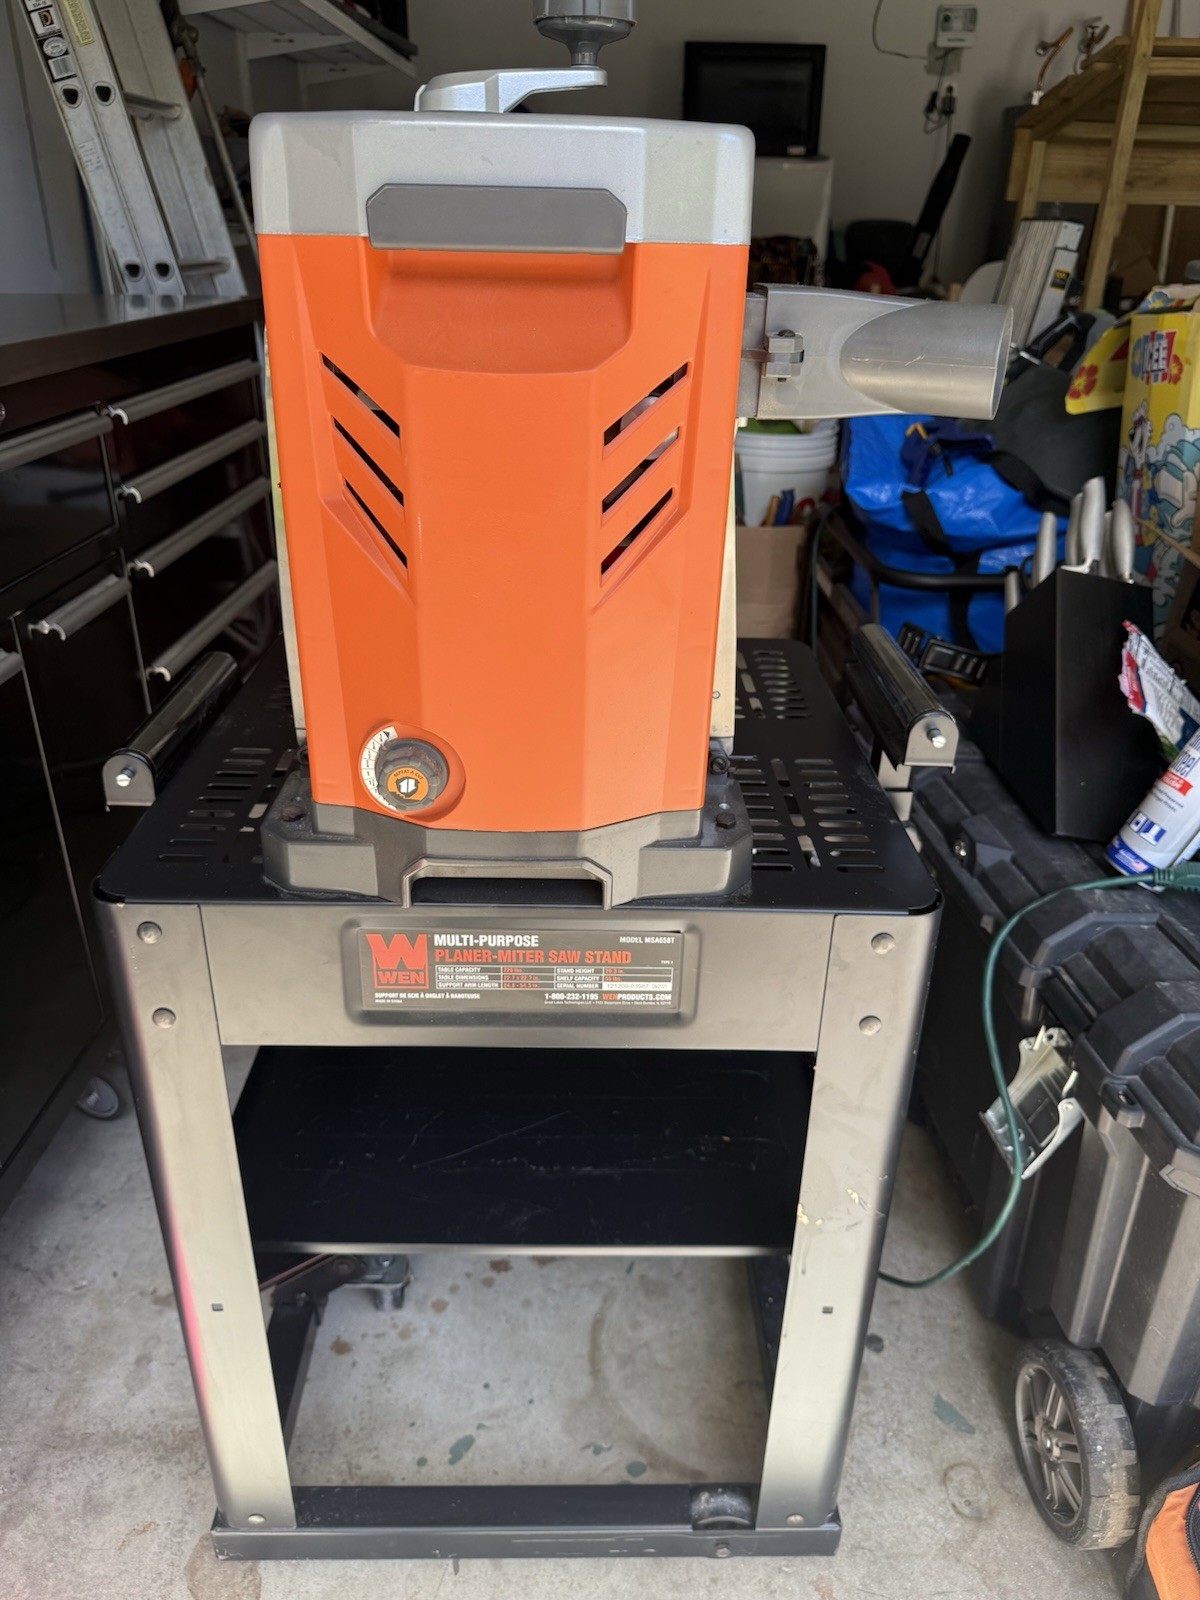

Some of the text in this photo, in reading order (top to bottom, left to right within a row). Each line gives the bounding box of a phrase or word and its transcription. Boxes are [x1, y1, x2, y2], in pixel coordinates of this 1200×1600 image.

[434, 934, 539, 947] MULTI-PURPOSE
[619, 936, 643, 944] MODEL
[435, 949, 632, 964] PLANER-MITER SAW STAND
[377, 971, 425, 985] WEN
[420, 991, 425, 999] À
[445, 991, 450, 999] À
[544, 993, 672, 1001] 1-800-232-1195 WENPRODUCTS.COM
